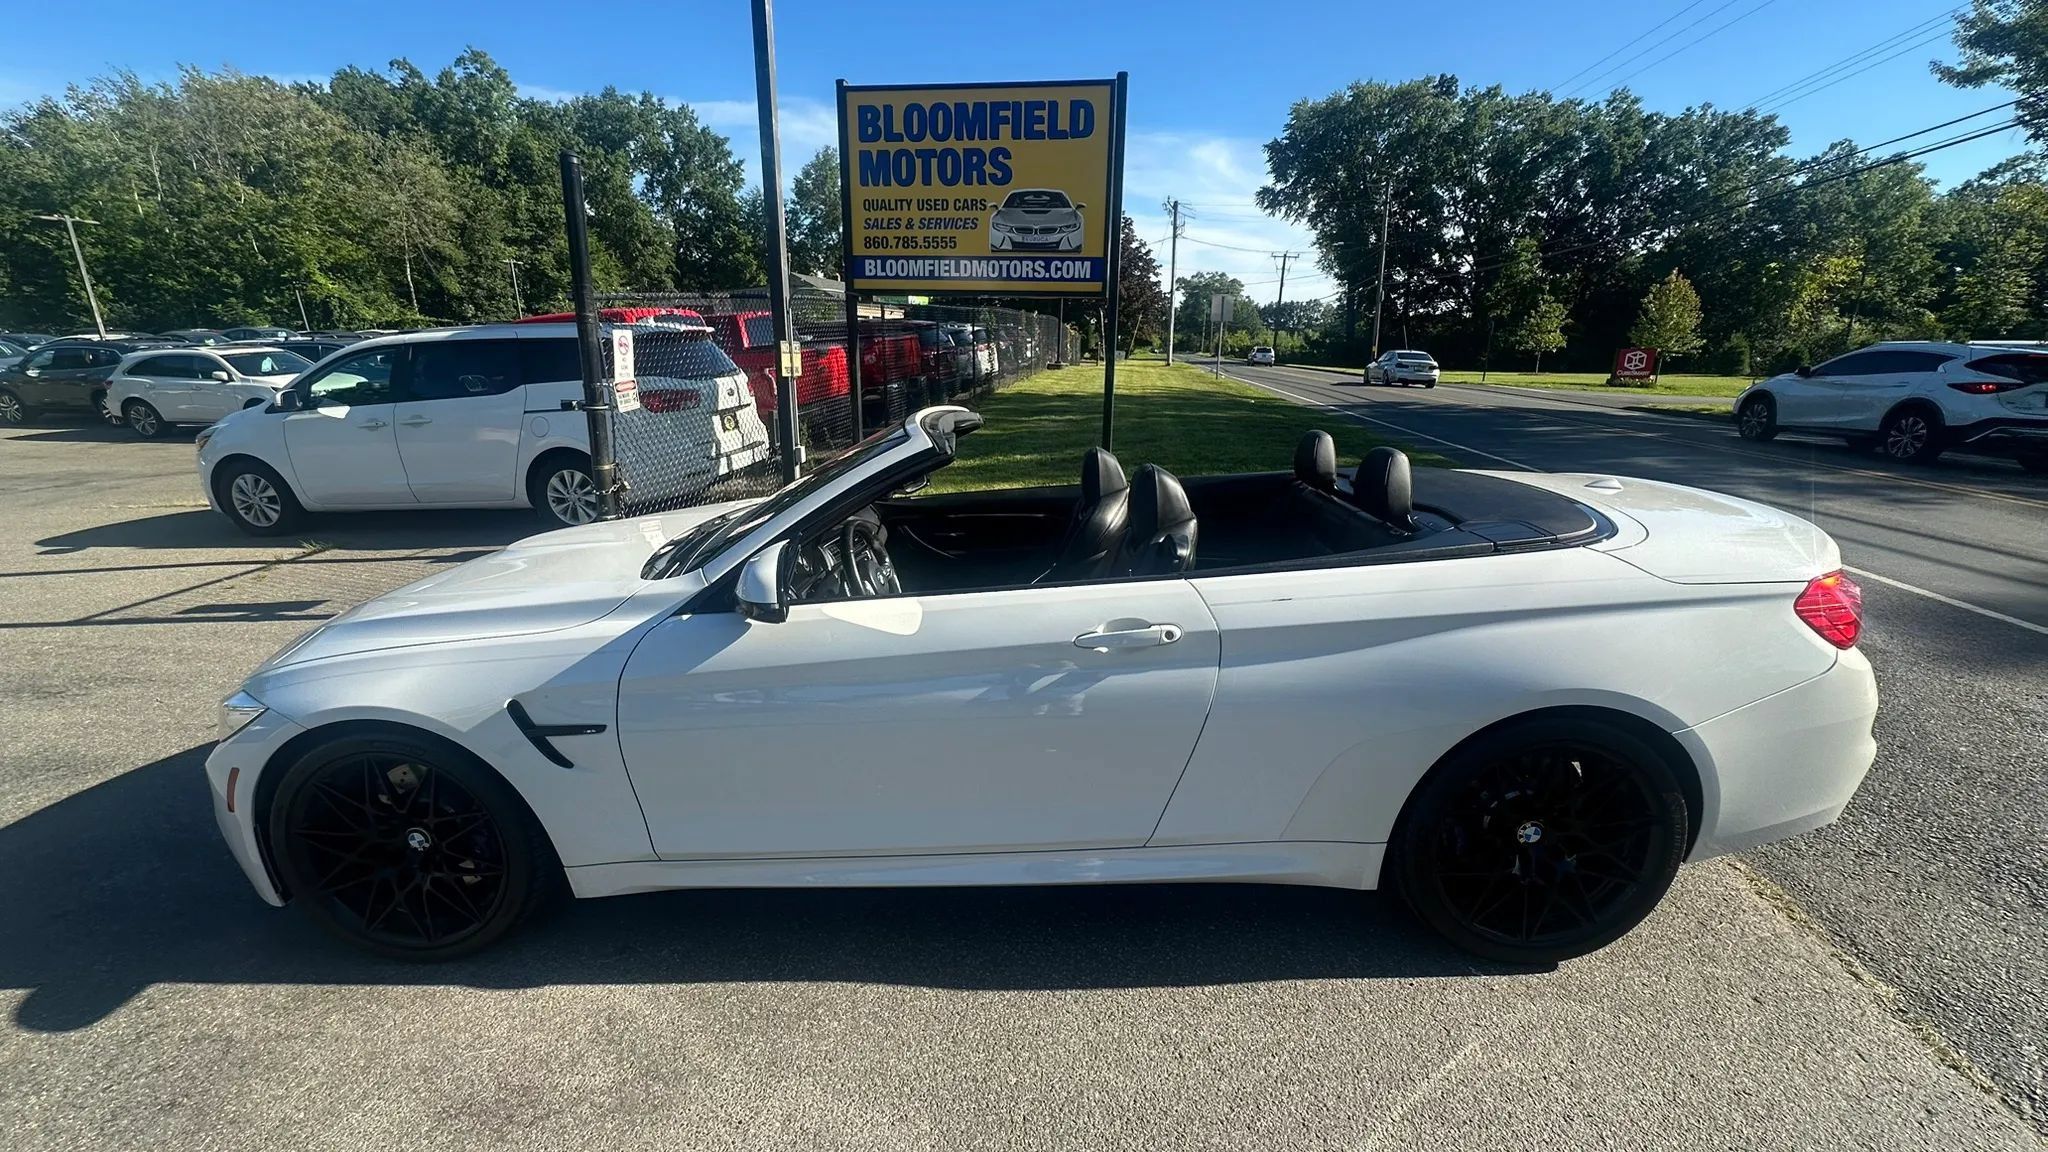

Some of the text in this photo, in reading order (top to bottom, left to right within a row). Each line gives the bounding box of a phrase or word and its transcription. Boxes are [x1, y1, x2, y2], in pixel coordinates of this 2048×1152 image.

[857, 99, 1095, 143] BLOOMFIELD
[858, 147, 1013, 187] MOTORS
[863, 198, 987, 212] QUALITY USED CARS
[863, 217, 979, 230] SALES & SERVICES
[863, 236, 957, 250] 860.785.5555
[865, 259, 1091, 279] BLOOMFIELDMOTORS.COM
